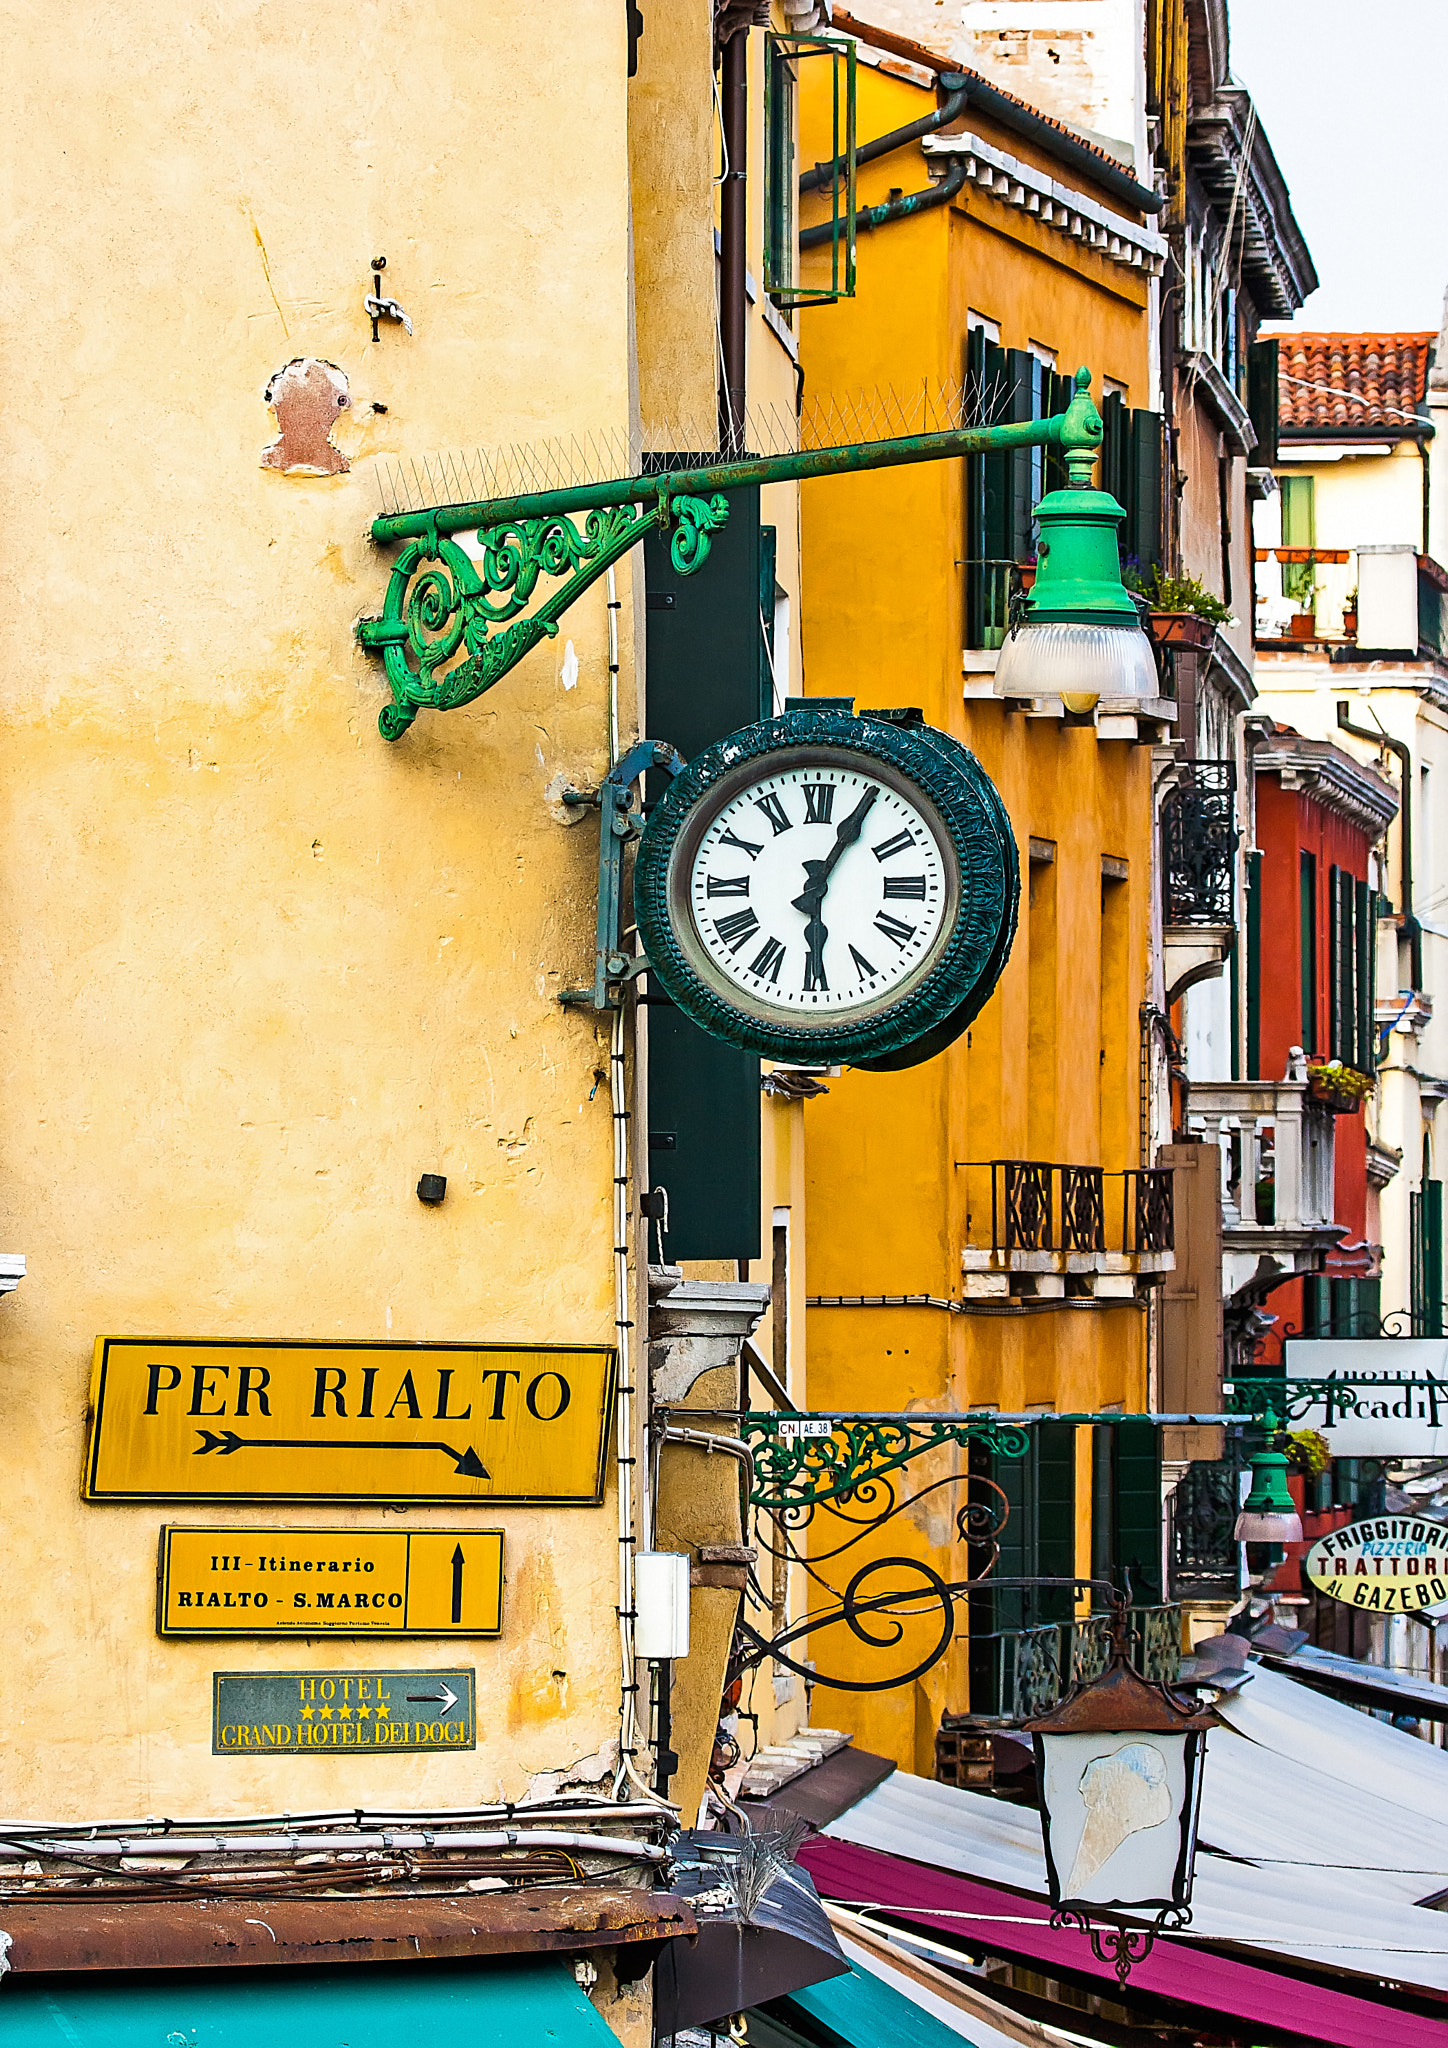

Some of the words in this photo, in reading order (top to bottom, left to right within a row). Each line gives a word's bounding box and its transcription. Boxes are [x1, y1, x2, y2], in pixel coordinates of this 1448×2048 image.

[753, 792, 793, 836] XI
[800, 784, 837, 824] XII
[719, 827, 765, 861] X
[871, 828, 917, 863] II
[707, 874, 750, 899] IX
[883, 875, 926, 901] III
[712, 907, 760, 954] VIII
[873, 910, 917, 951] IV
[748, 936, 787, 984] VII
[848, 943, 878, 983] V
[143, 1364, 273, 1417] PER
[311, 1367, 571, 1421] RIALTO
[1321, 1520, 1448, 1557] FRIGGITORI
[1361, 1541, 1428, 1557] PIZZERIA
[177, 1592, 269, 1608] RIALTO
[1326, 1579, 1343, 1599] AL
[1353, 1578, 1447, 1610] GAZEBO
[300, 1678, 391, 1700] HOTEL
[221, 1725, 292, 1747] GRAND
[297, 1723, 370, 1746] HOTEL
[375, 1721, 410, 1744] DEI
[415, 1720, 466, 1744] DOGI
